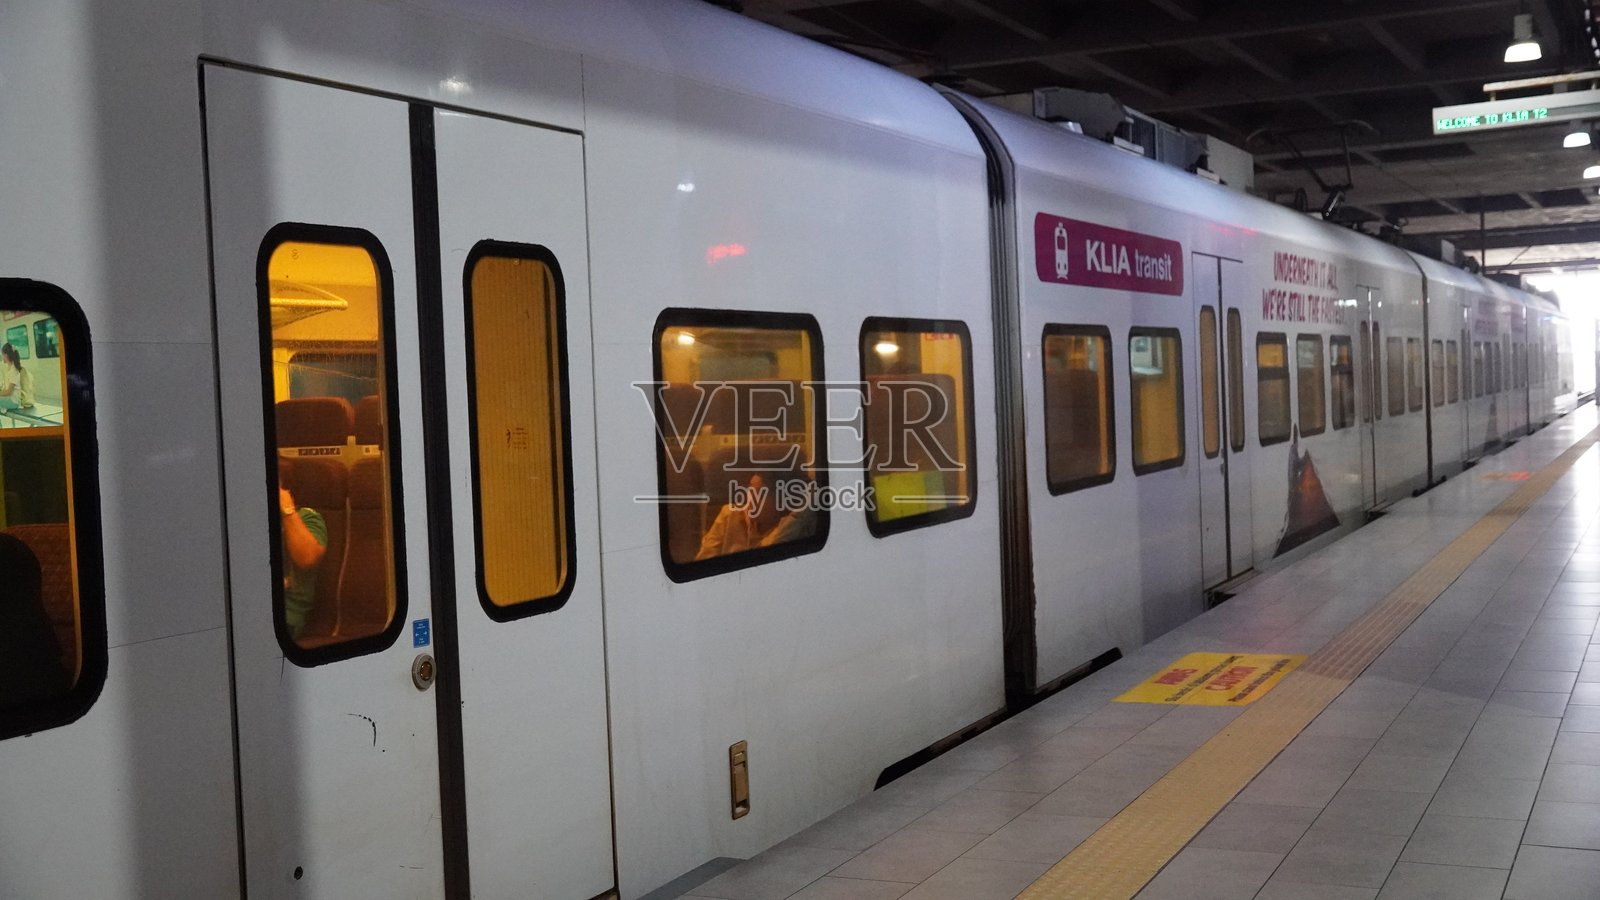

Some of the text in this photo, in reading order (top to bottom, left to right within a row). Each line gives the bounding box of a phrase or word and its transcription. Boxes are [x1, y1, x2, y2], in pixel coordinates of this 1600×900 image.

[1437, 107, 1548, 130] WELCOME TO KLIA T2
[1086, 239, 1172, 281] KLIA transit
[1274, 250, 1318, 288] UNDERNEATH
[1319, 261, 1326, 288] IT
[1263, 288, 1286, 321] WE'RE
[1288, 291, 1305, 322] STILL
[1308, 294, 1320, 323] THE
